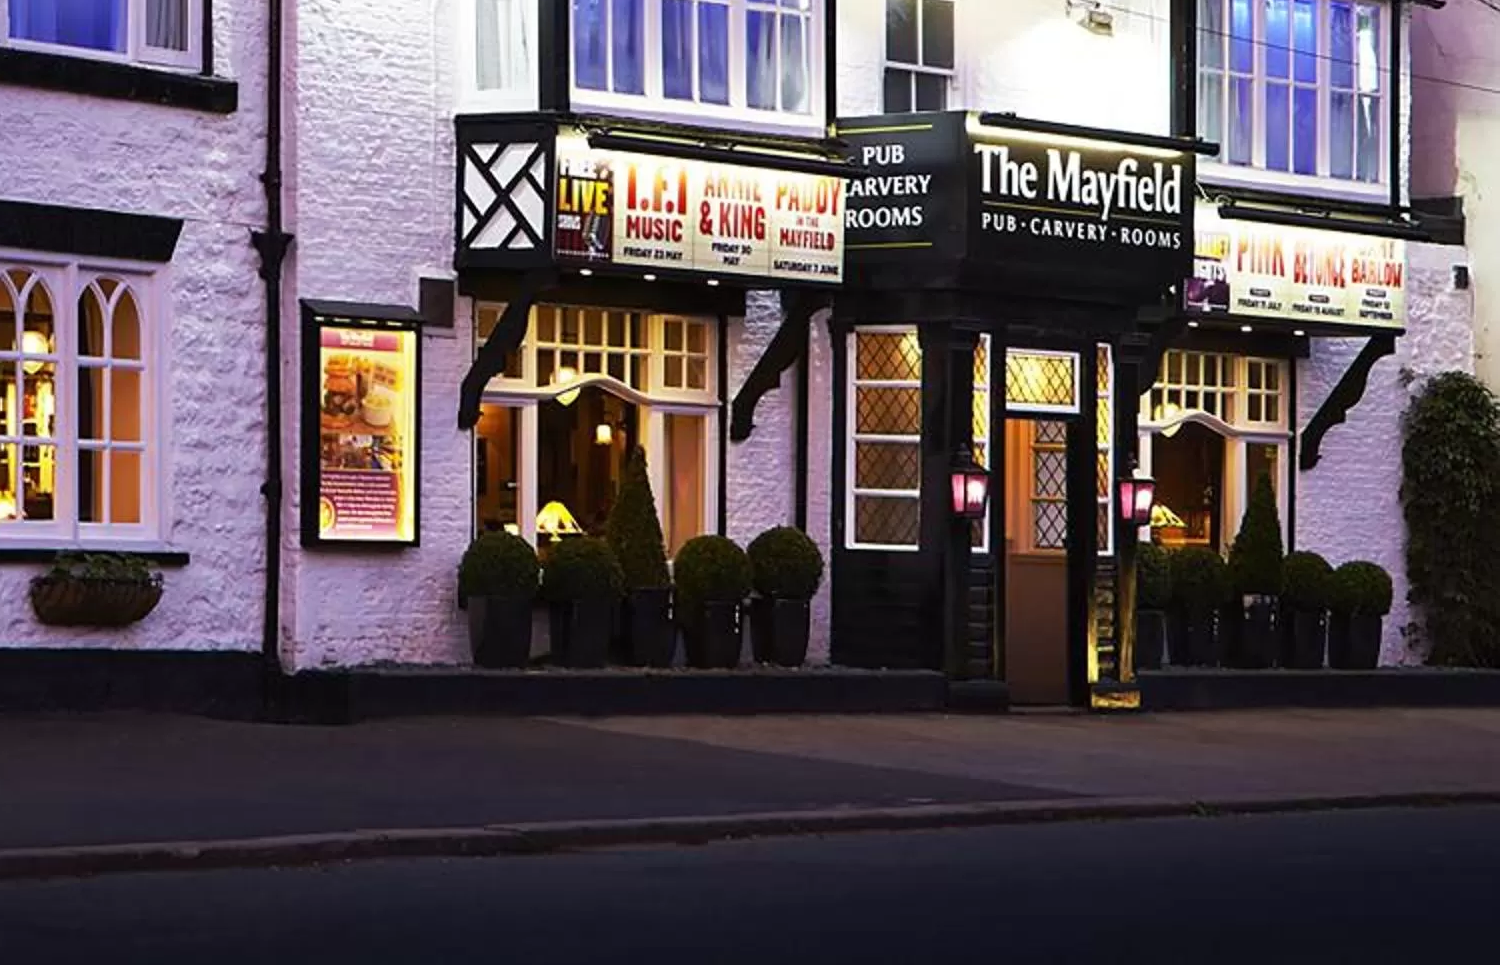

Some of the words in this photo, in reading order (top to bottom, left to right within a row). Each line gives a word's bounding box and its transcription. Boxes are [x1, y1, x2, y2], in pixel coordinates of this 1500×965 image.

[862, 144, 905, 166] PUB
[558, 178, 609, 215] LIVE
[973, 143, 1038, 199] The
[1047, 148, 1182, 221] Mayfield
[626, 215, 683, 243] MUSIC
[700, 200, 713, 235] &
[719, 202, 766, 240] KING
[845, 206, 924, 228] ROOMS
[981, 212, 1017, 233] PUB
[1029, 218, 1108, 242] CARVERY
[1120, 227, 1182, 250] ROOMS
[780, 228, 835, 251] MAYFIELD
